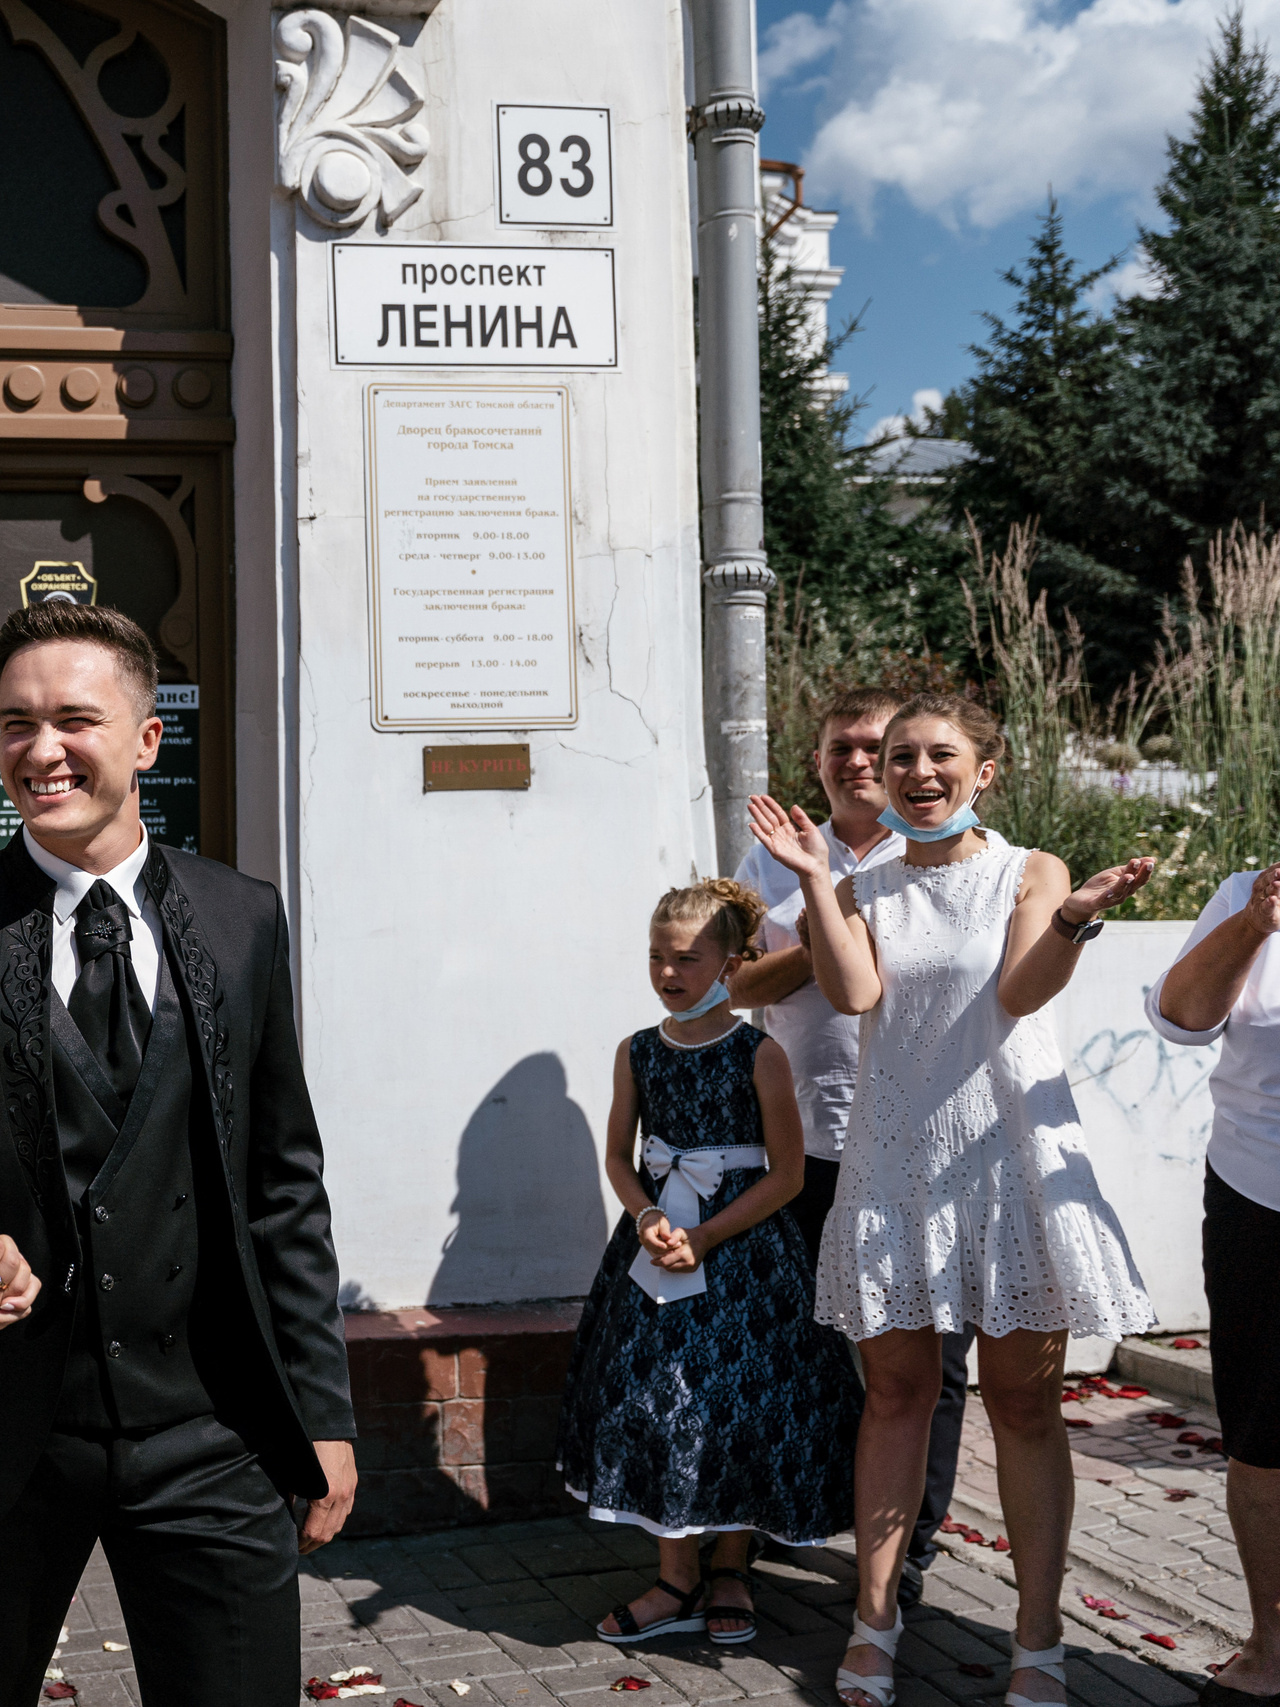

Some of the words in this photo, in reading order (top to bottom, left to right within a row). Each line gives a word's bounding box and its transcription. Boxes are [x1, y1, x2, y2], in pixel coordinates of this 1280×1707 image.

[517, 133, 594, 198] 83
[401, 263, 546, 293] проспект
[377, 304, 578, 349] ЛЕНИНА
[448, 400, 473, 409] ЗАГС
[476, 400, 515, 410] Томской
[517, 400, 555, 410] области
[396, 424, 442, 437] Дворец
[445, 424, 543, 437] бракосочетаний
[427, 440, 469, 452] города
[472, 440, 514, 451] Томска
[425, 478, 459, 488] Прием
[462, 477, 518, 487] заявлений
[417, 494, 430, 502] на
[433, 493, 526, 503] государственную
[384, 508, 455, 518] регистрацию
[457, 508, 522, 518] заключения
[416, 532, 461, 541] вторник
[398, 551, 430, 561] среда
[439, 552, 482, 561] четверг
[393, 587, 485, 598] Государственная
[487, 588, 554, 598] регистрация
[423, 603, 488, 612] заключения
[493, 633, 515, 642] 9.00
[526, 633, 554, 642] 18.00
[415, 661, 461, 670] перерыв
[403, 690, 470, 699] воскресенье
[479, 689, 550, 698] понедельник
[450, 701, 504, 710] выходной
[431, 760, 454, 774] НЕ
[458, 758, 527, 773] КУРИТЬ
